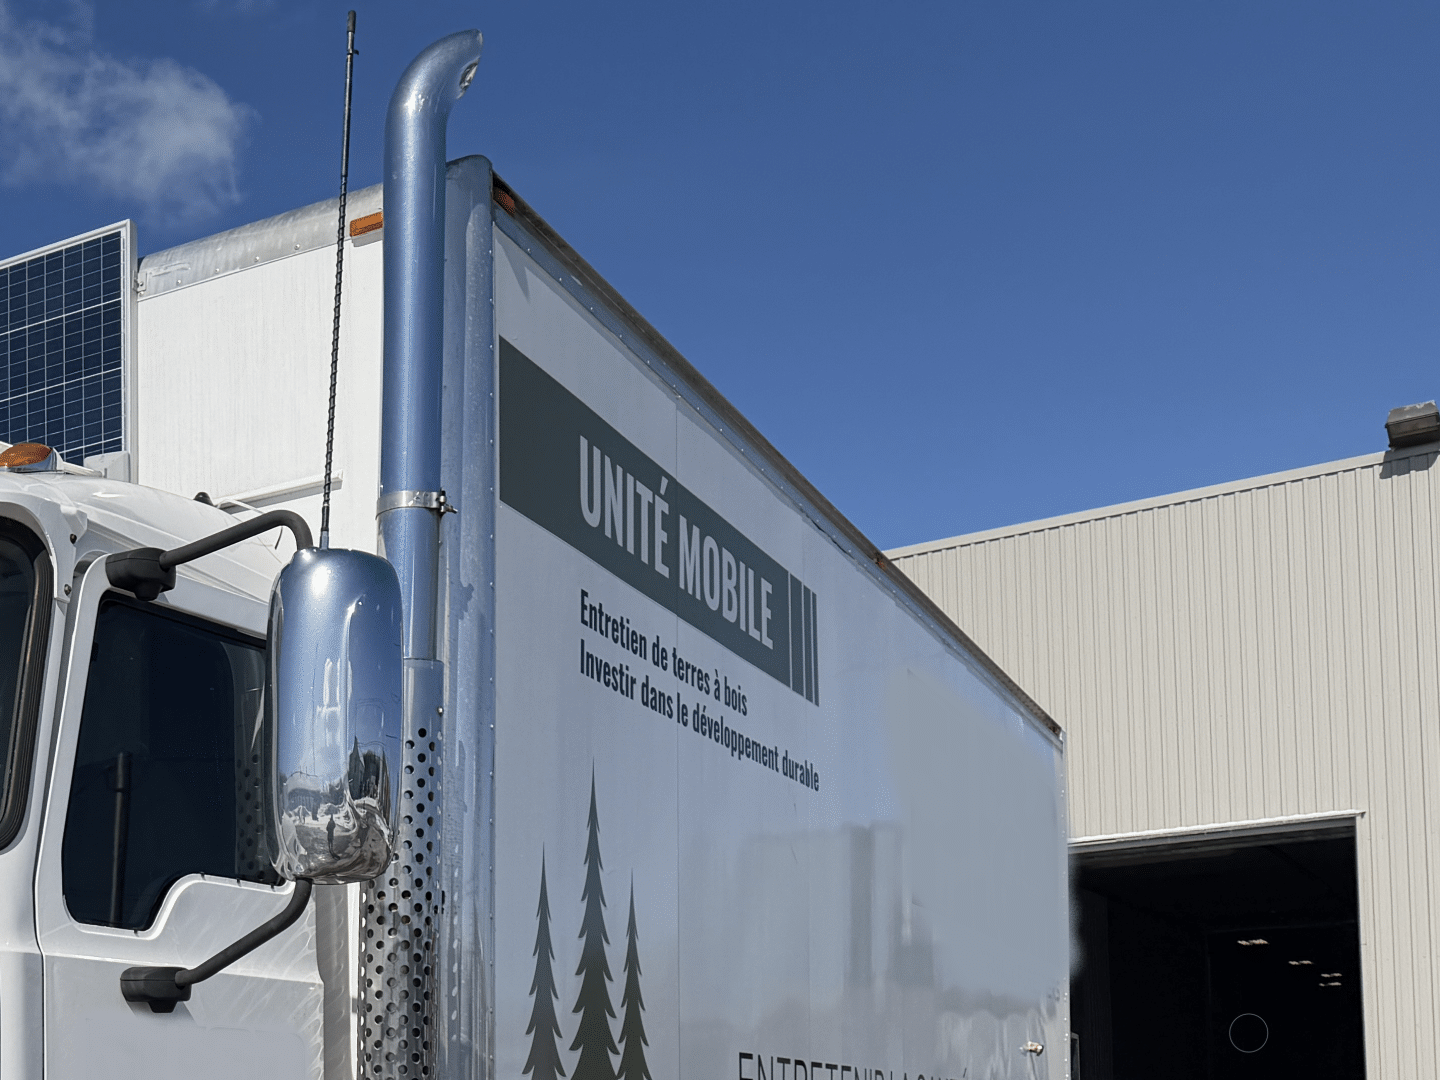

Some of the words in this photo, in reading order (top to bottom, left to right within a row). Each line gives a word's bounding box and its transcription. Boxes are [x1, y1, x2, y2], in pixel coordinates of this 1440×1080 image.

[579, 434, 670, 580] UNITÉ
[678, 514, 774, 650] MOBILE
[580, 588, 647, 661] Entretien
[651, 634, 668, 672] de
[672, 646, 710, 696] terres
[714, 668, 721, 702] à
[724, 675, 748, 717] bois
[580, 637, 637, 701] Investir
[641, 674, 674, 720] dans
[676, 691, 689, 728] le
[692, 701, 780, 775] développement
[782, 749, 820, 792] durable
